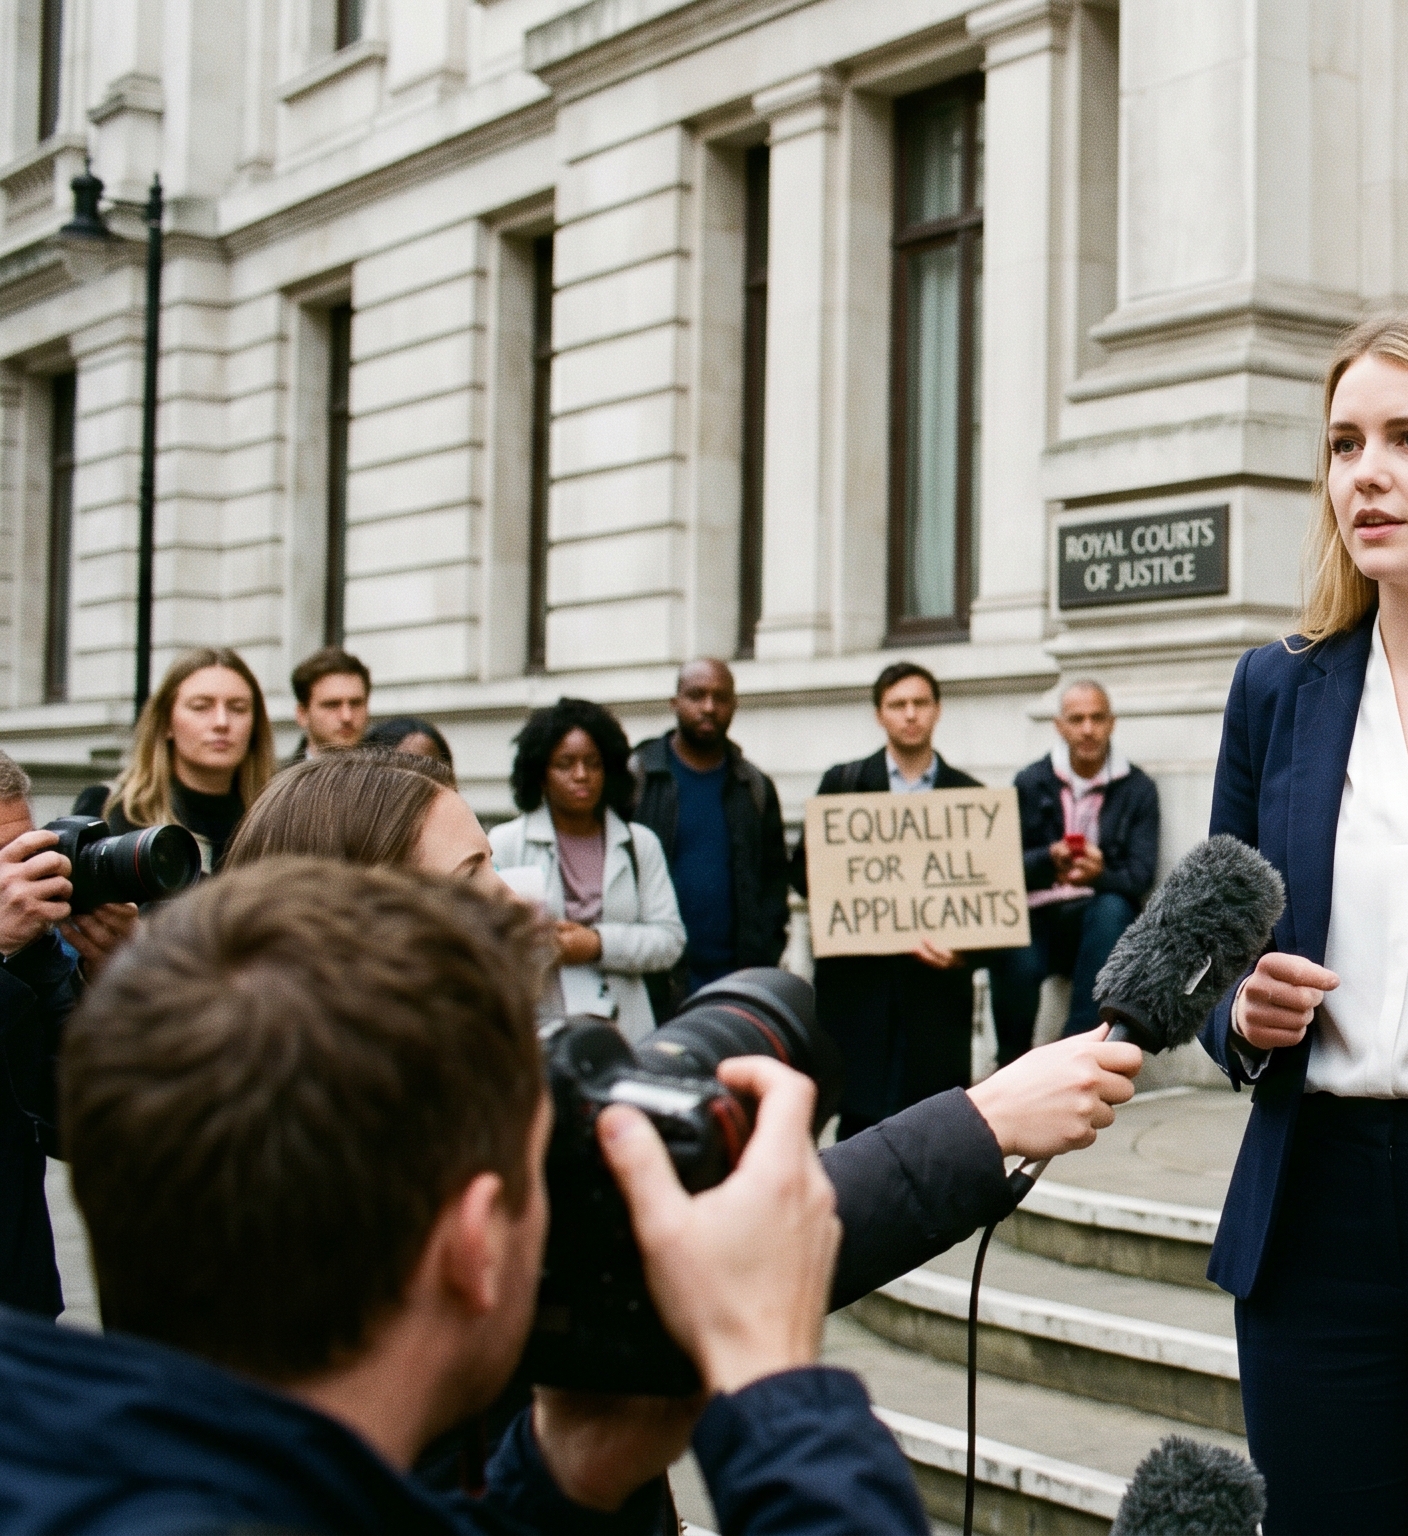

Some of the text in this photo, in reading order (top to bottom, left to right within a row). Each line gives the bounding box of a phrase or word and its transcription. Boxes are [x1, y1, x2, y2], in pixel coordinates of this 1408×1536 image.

[1065, 517, 1215, 563] ROYAL COURTS
[1083, 553, 1196, 592] OF JUSTICE
[823, 802, 1000, 846] EQUALITY
[847, 850, 987, 885] FOR ALL
[828, 889, 1021, 937] APPLICANTS
